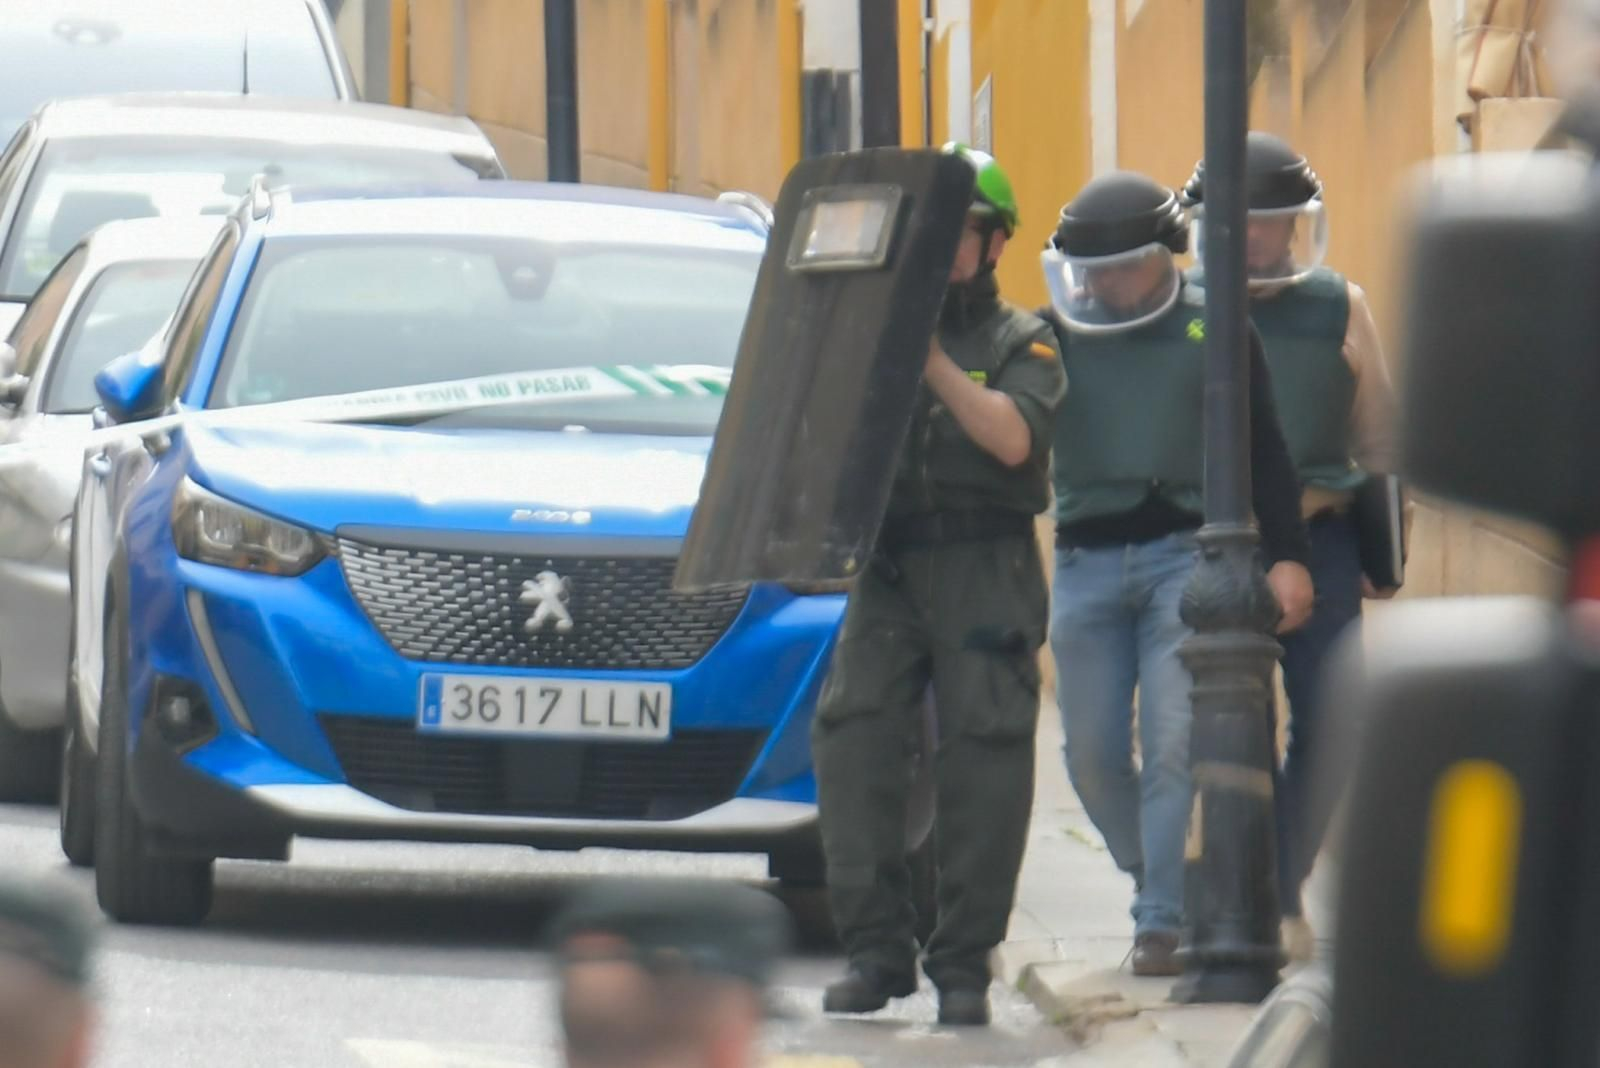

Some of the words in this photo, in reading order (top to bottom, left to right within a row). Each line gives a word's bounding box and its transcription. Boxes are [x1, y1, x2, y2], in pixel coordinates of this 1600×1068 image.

[478, 380, 512, 399] NO
[516, 374, 592, 395] PASAR
[451, 683, 563, 725] 3617
[579, 688, 662, 729] LLN
